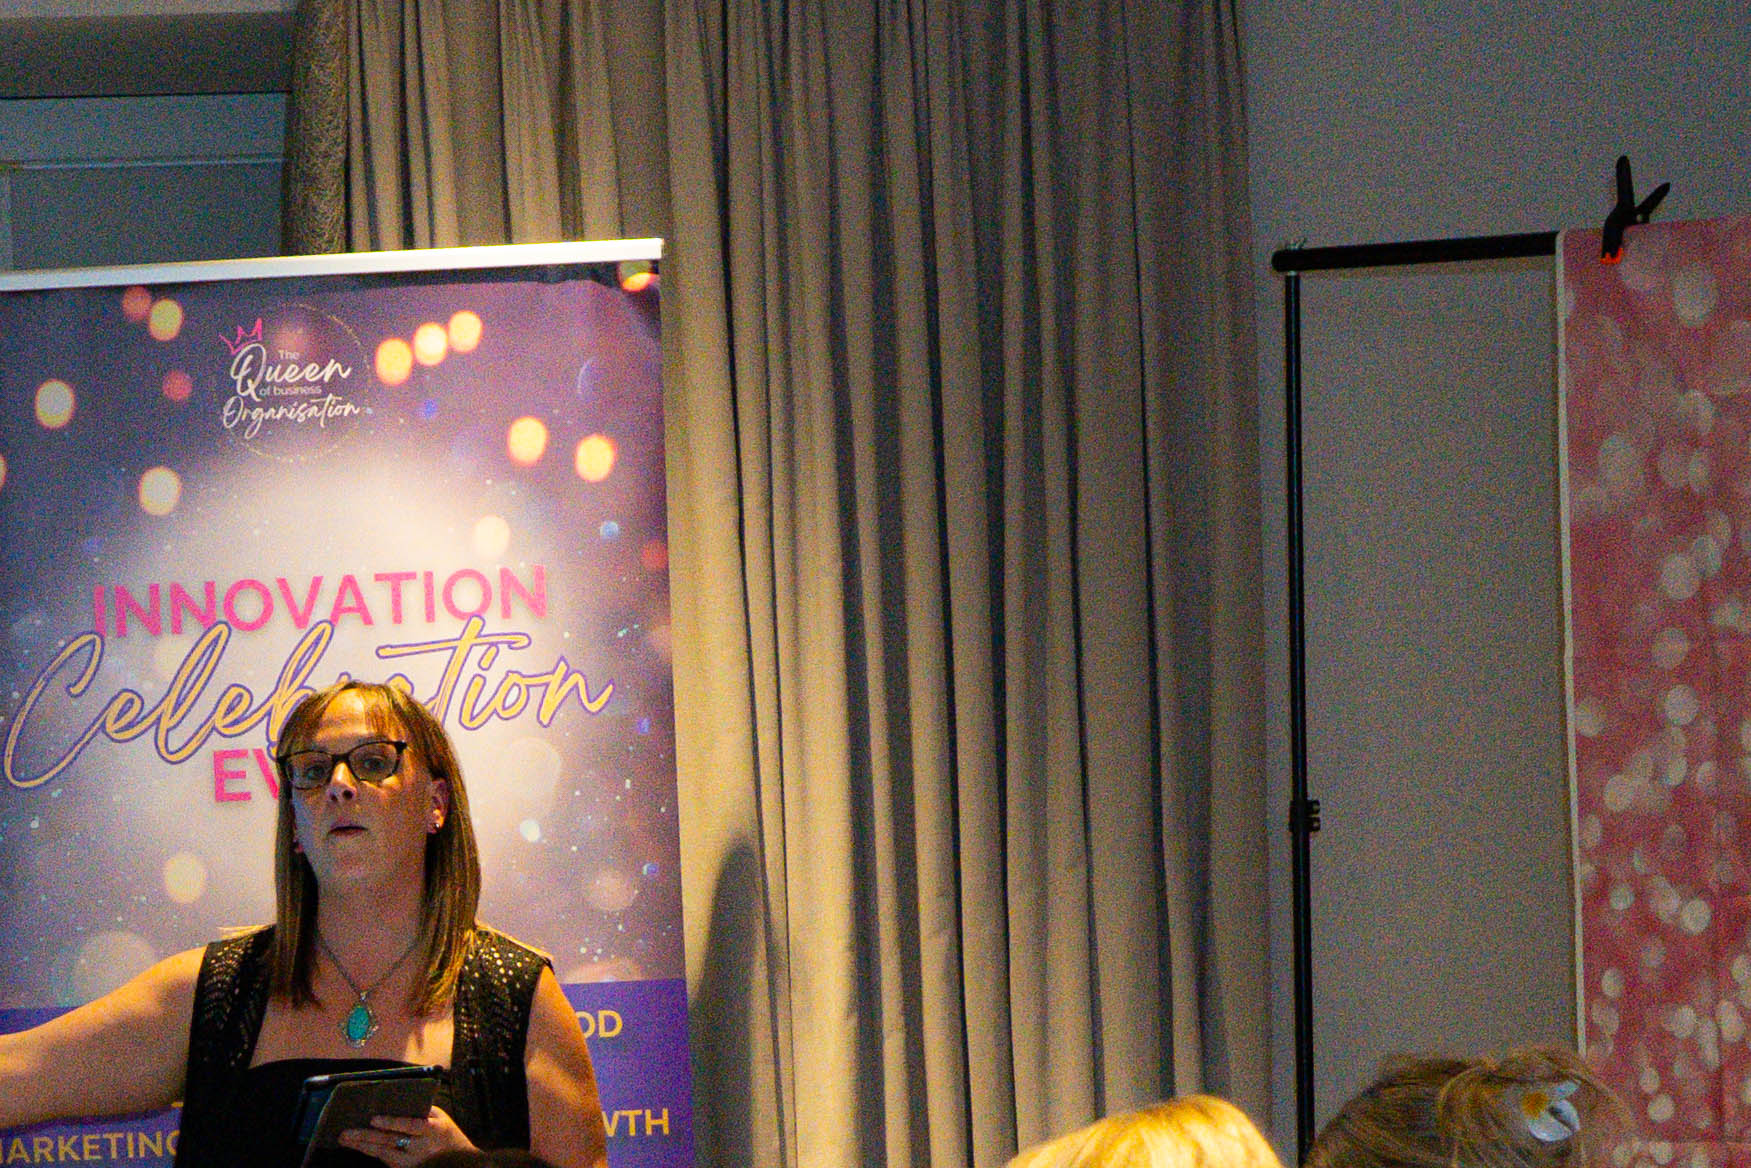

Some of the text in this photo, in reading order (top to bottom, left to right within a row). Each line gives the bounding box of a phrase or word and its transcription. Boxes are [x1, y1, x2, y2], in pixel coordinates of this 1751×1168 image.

[230, 343, 352, 402] Queen
[259, 385, 322, 397] of business
[223, 393, 361, 439] Organisation
[91, 564, 548, 638] INNOVATION
[4, 615, 615, 788] Celebtion
